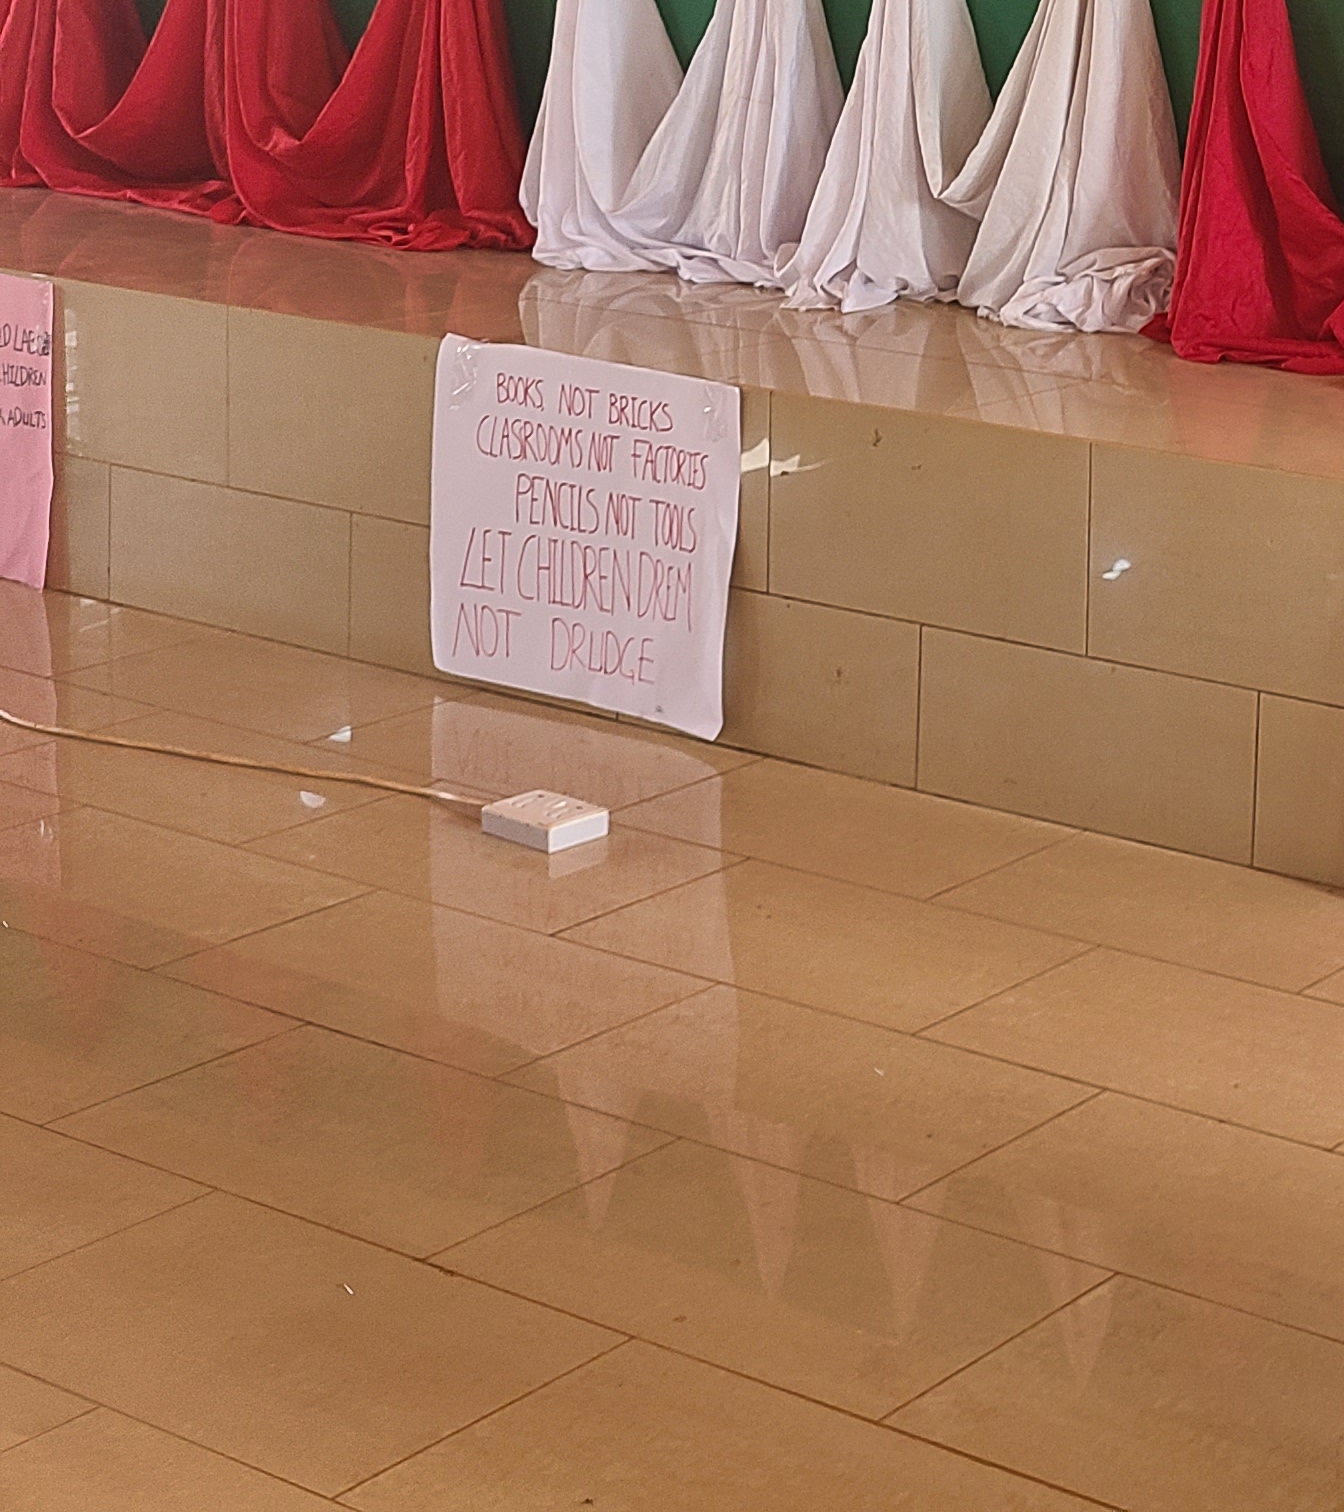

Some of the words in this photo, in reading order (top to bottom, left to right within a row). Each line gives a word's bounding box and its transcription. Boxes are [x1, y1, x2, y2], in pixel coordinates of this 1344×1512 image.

[8, 406, 46, 429] ADULTS
[558, 384, 600, 420] NOT
[608, 393, 673, 432] BRICKS
[588, 431, 620, 473] NOT
[631, 438, 710, 491] FACTORIES
[515, 473, 600, 535] PENCILS
[605, 491, 643, 541] NOT
[649, 498, 697, 555] TOOLS
[460, 527, 513, 594] LET
[517, 534, 632, 617] CHILDREN
[452, 602, 523, 660] NOT
[550, 616, 655, 686] DRUDGE
